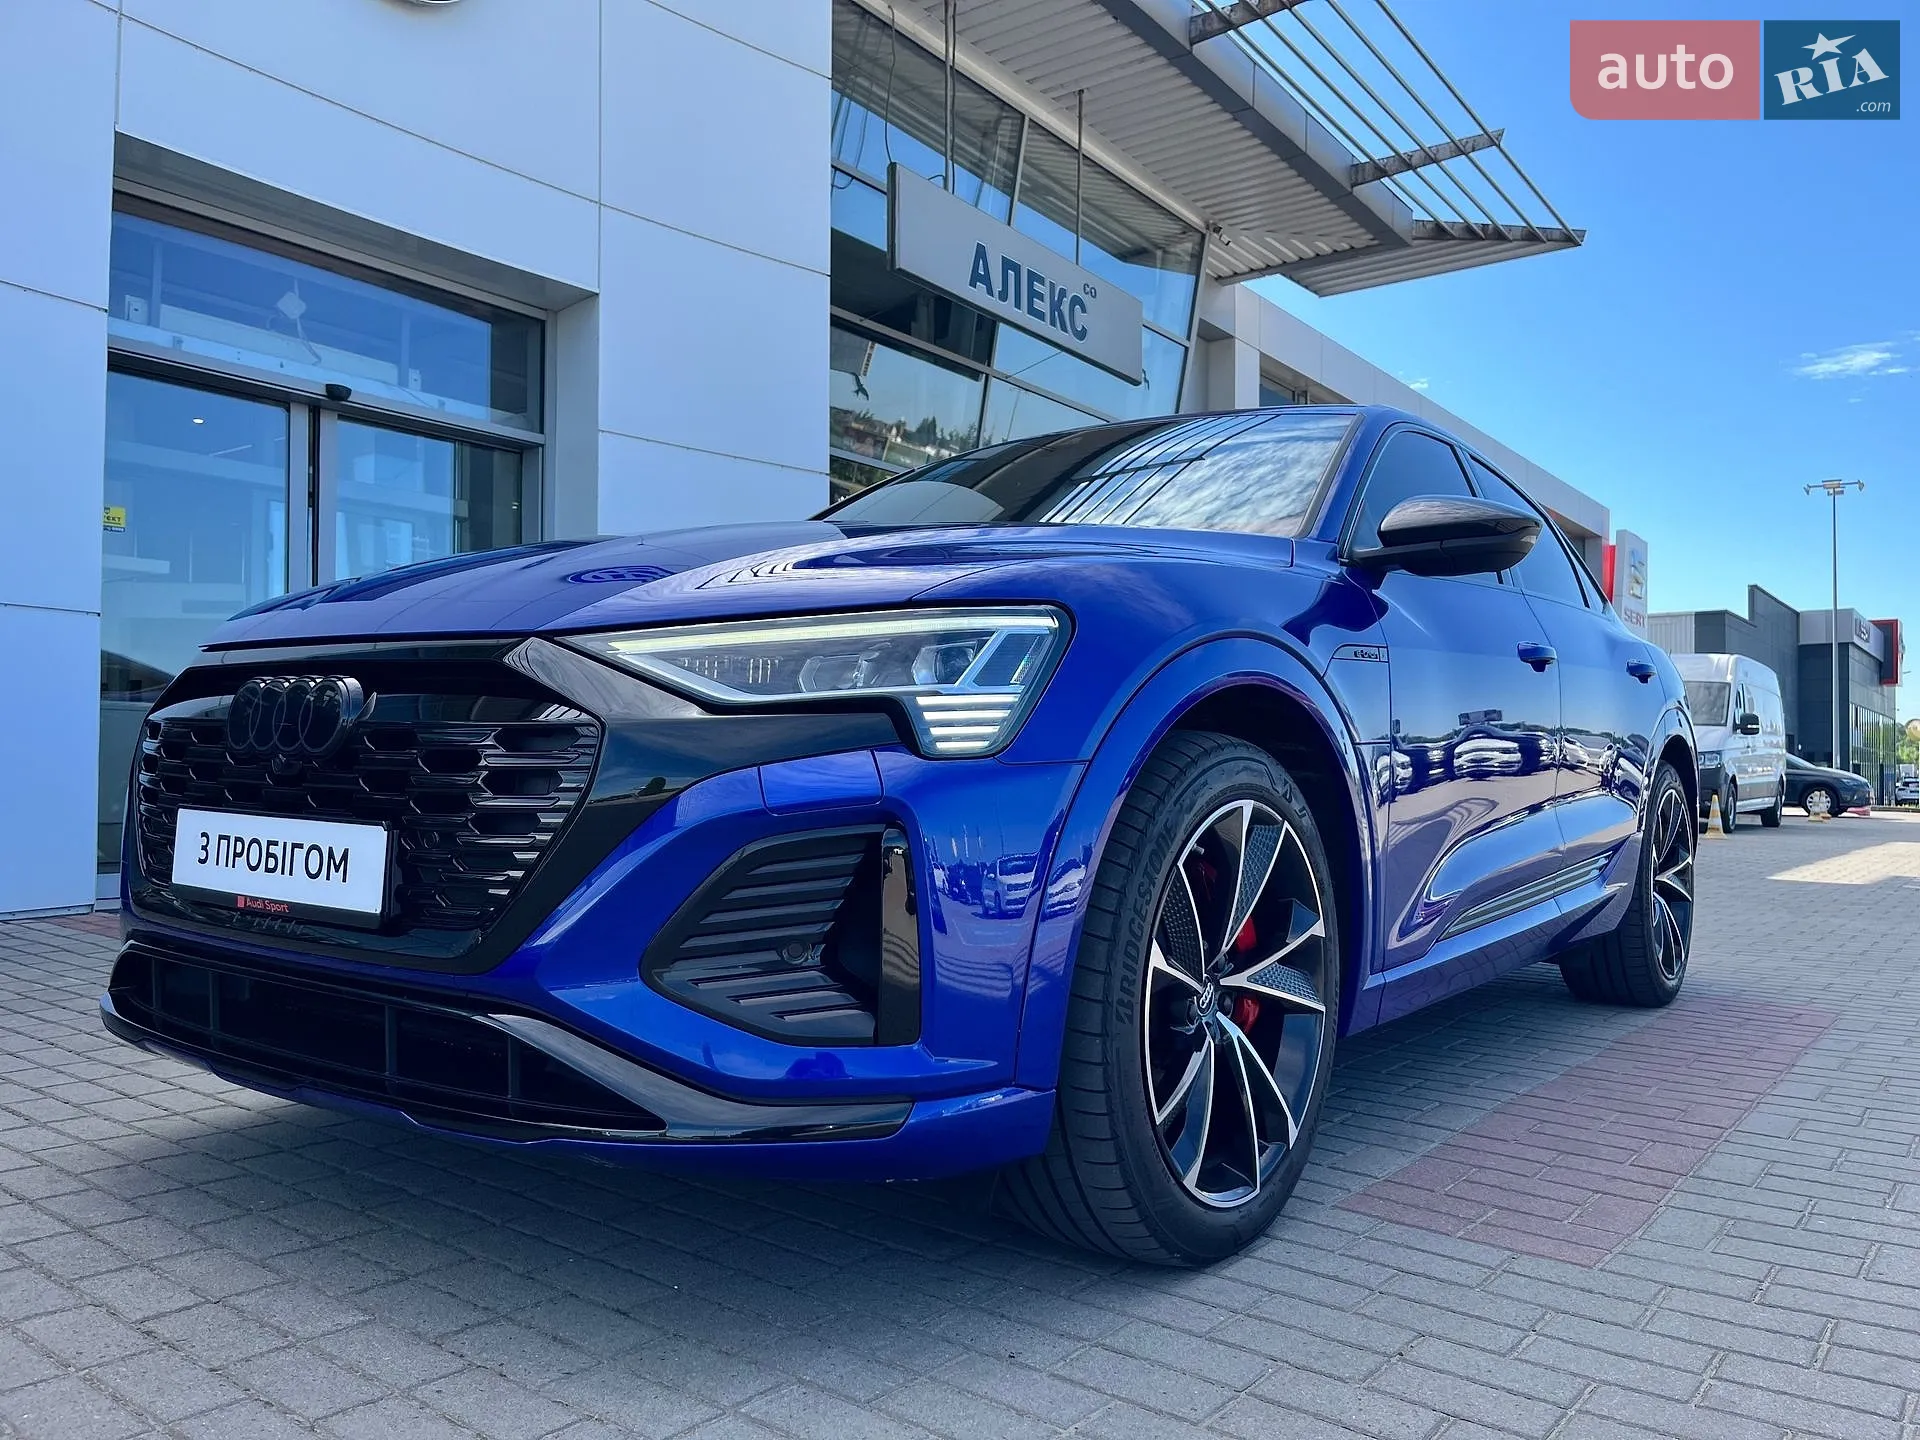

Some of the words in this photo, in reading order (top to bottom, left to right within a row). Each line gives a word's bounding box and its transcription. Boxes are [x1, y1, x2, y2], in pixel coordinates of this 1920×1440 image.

[968, 240, 1088, 343] АЛЕКС
[215, 834, 350, 883] ПРОБІГОМ
[246, 897, 264, 909] Audi
[264, 900, 290, 913] Sport
[1115, 818, 1178, 1026] BRIDGESTONE
